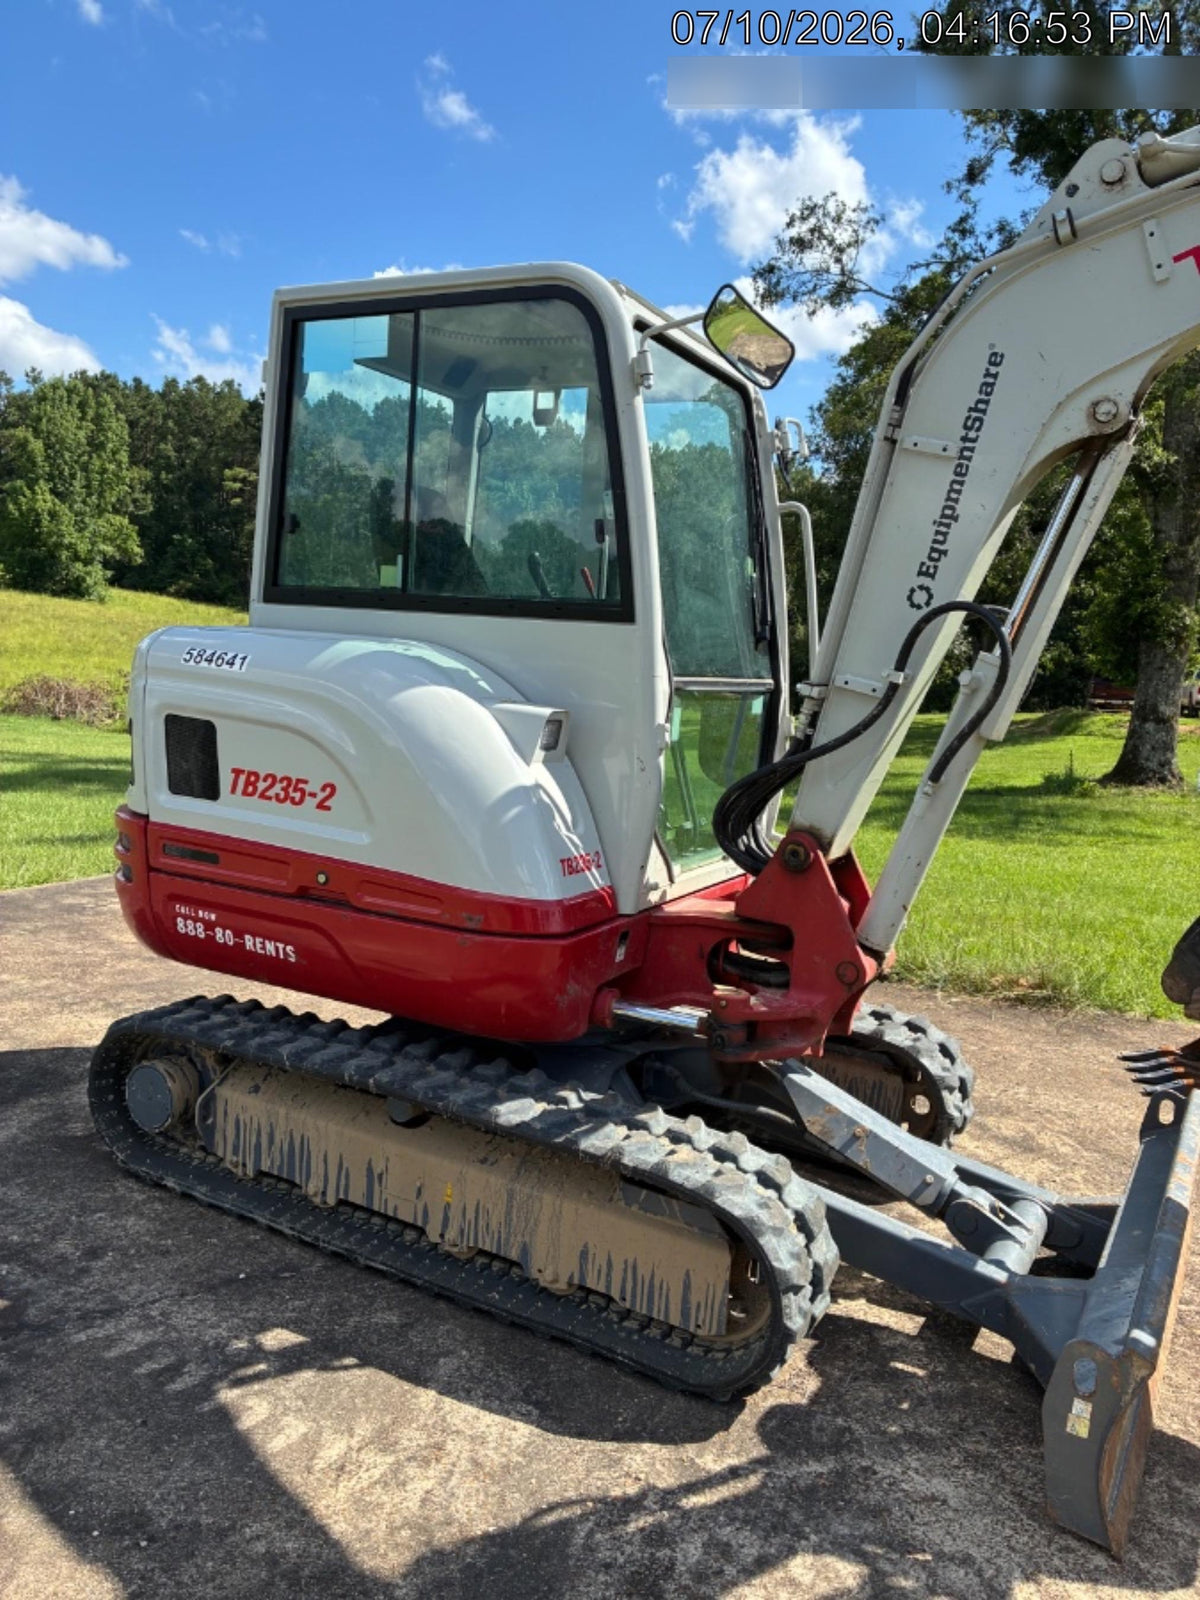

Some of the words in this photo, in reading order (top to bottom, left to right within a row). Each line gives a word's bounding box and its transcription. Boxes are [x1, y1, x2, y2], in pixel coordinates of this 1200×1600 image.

[183, 648, 247, 670] 584641
[229, 767, 337, 811] TB235-2
[175, 904, 195, 916] CALL
[198, 909, 216, 921] NOW
[176, 917, 296, 962] 888-80-RENTS
